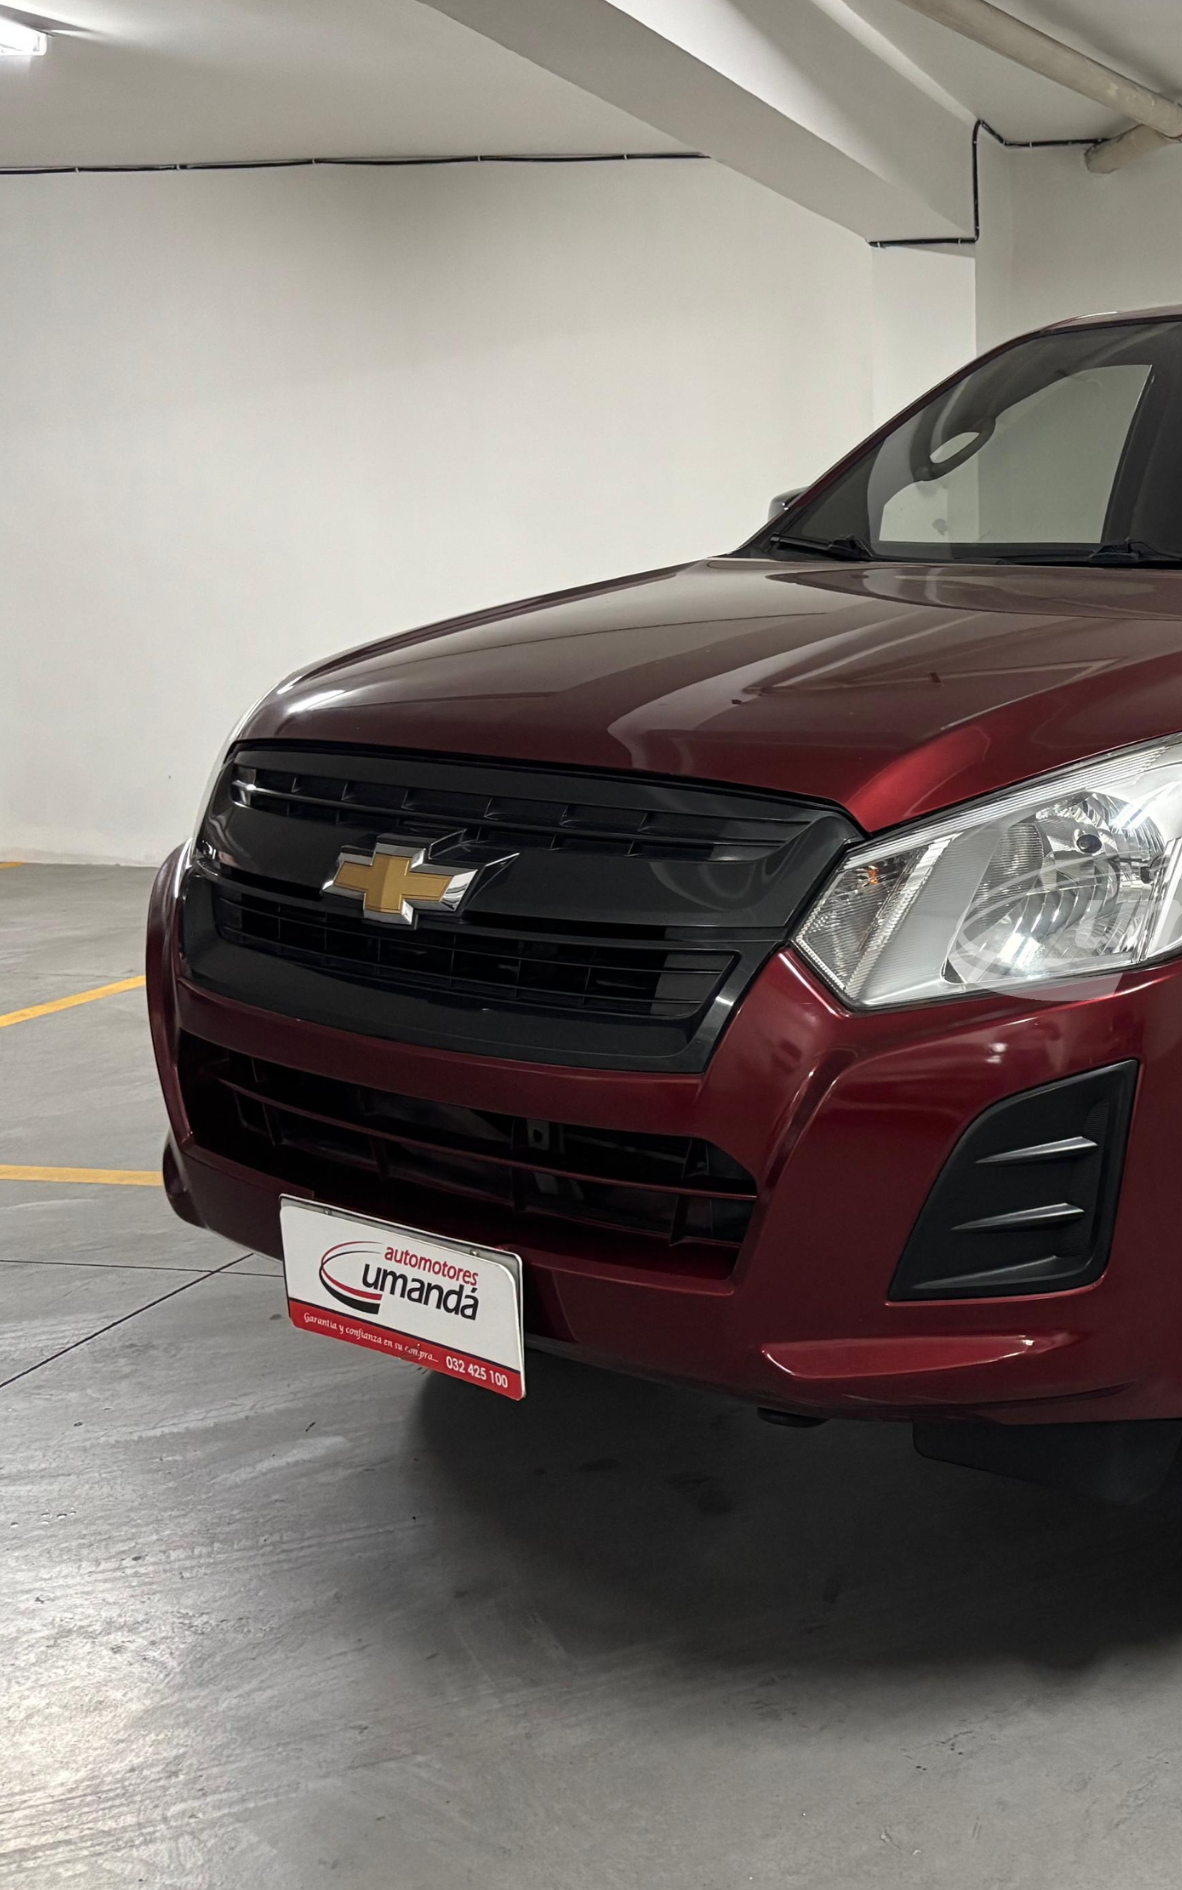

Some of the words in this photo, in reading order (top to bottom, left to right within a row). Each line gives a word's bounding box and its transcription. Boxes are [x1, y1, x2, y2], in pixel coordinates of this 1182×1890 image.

[362, 1263, 479, 1321] umandá
[384, 1246, 479, 1286] automotores
[338, 1324, 344, 1335] y
[345, 1324, 382, 1344] confianza
[383, 1340, 393, 1348] en
[445, 1355, 466, 1374] 032
[467, 1363, 487, 1381] 425
[489, 1370, 508, 1389] 100
